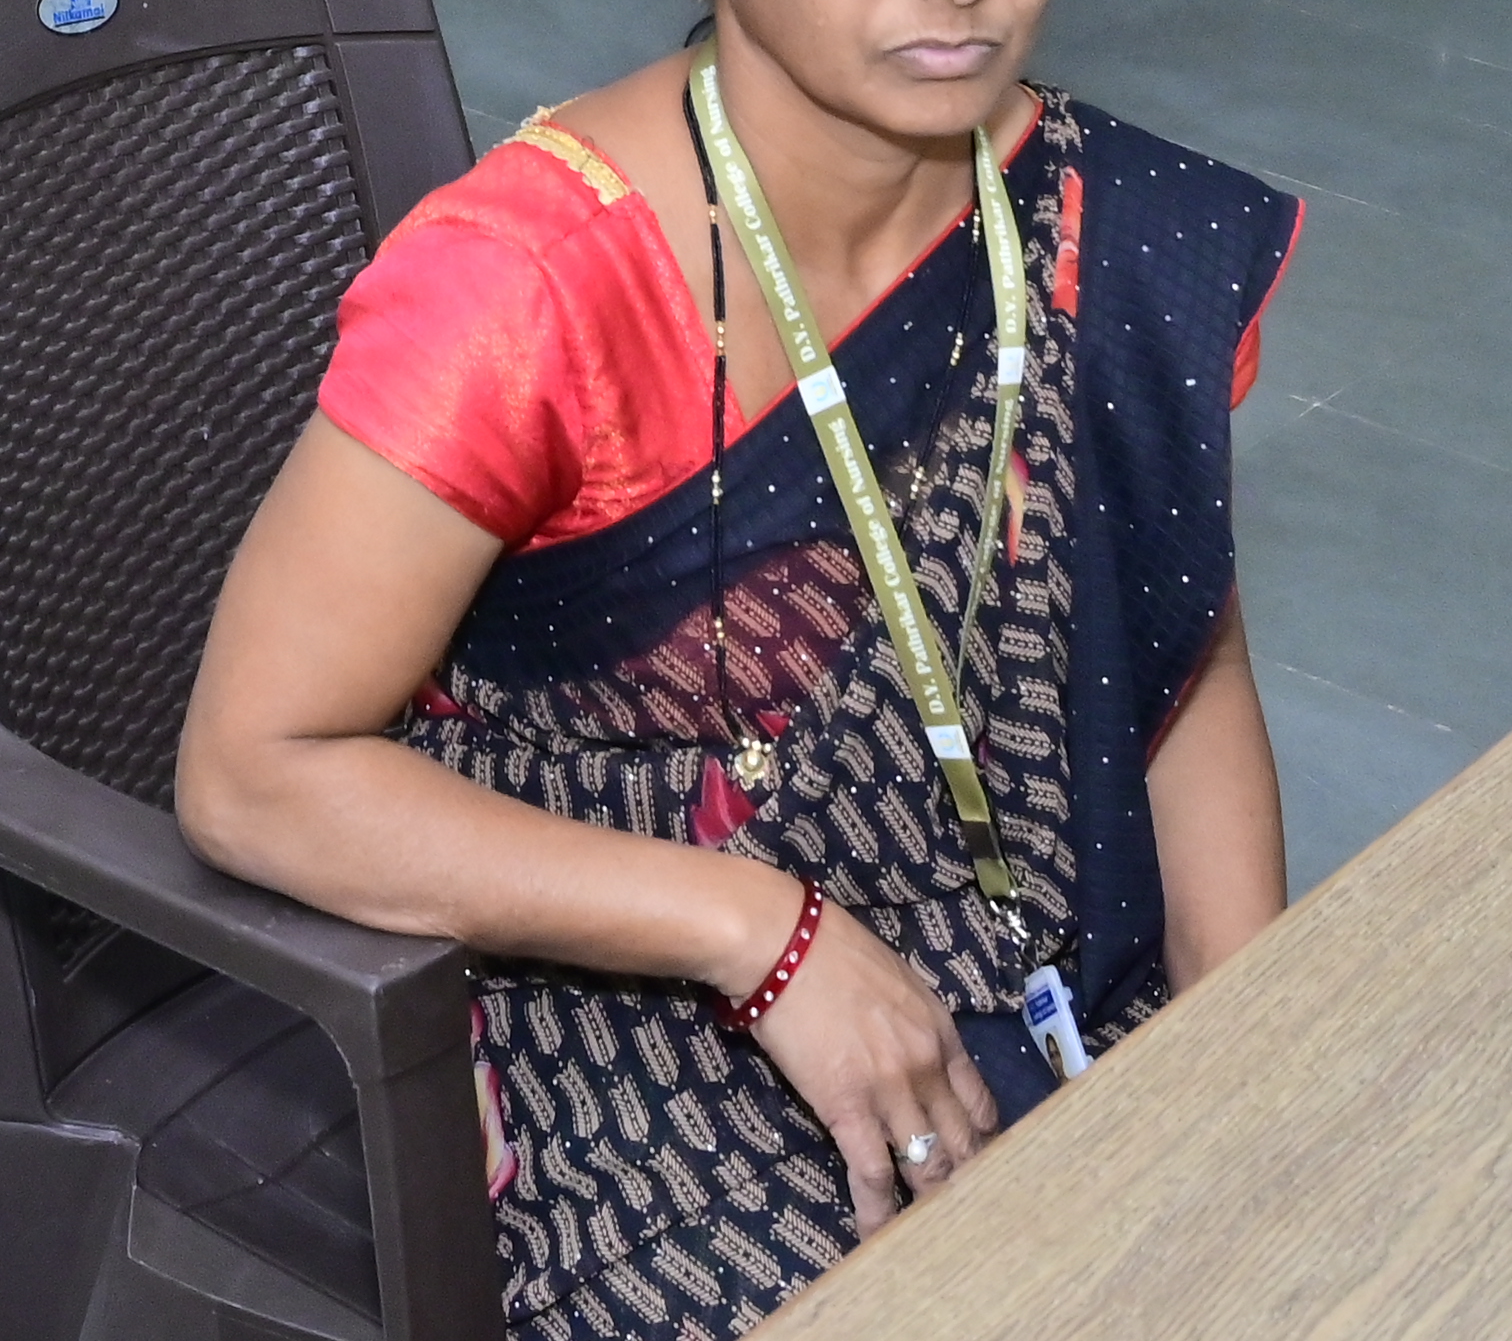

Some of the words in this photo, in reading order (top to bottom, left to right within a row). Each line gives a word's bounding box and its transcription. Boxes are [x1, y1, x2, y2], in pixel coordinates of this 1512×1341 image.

[53, 4, 104, 23] Nilkamal
[700, 65, 721, 135] Nursing
[714, 138, 733, 156] of
[724, 163, 762, 230] College
[755, 234, 801, 321] Pathrikar
[991, 199, 1018, 289] Pathrikar
[794, 323, 817, 363] D.Y.
[1005, 296, 1018, 334] D.Y.
[827, 417, 866, 494] Nursing
[855, 498, 874, 515] of
[868, 520, 899, 587] College
[893, 591, 930, 675] Pathrikar
[923, 678, 945, 715] D.Y.
